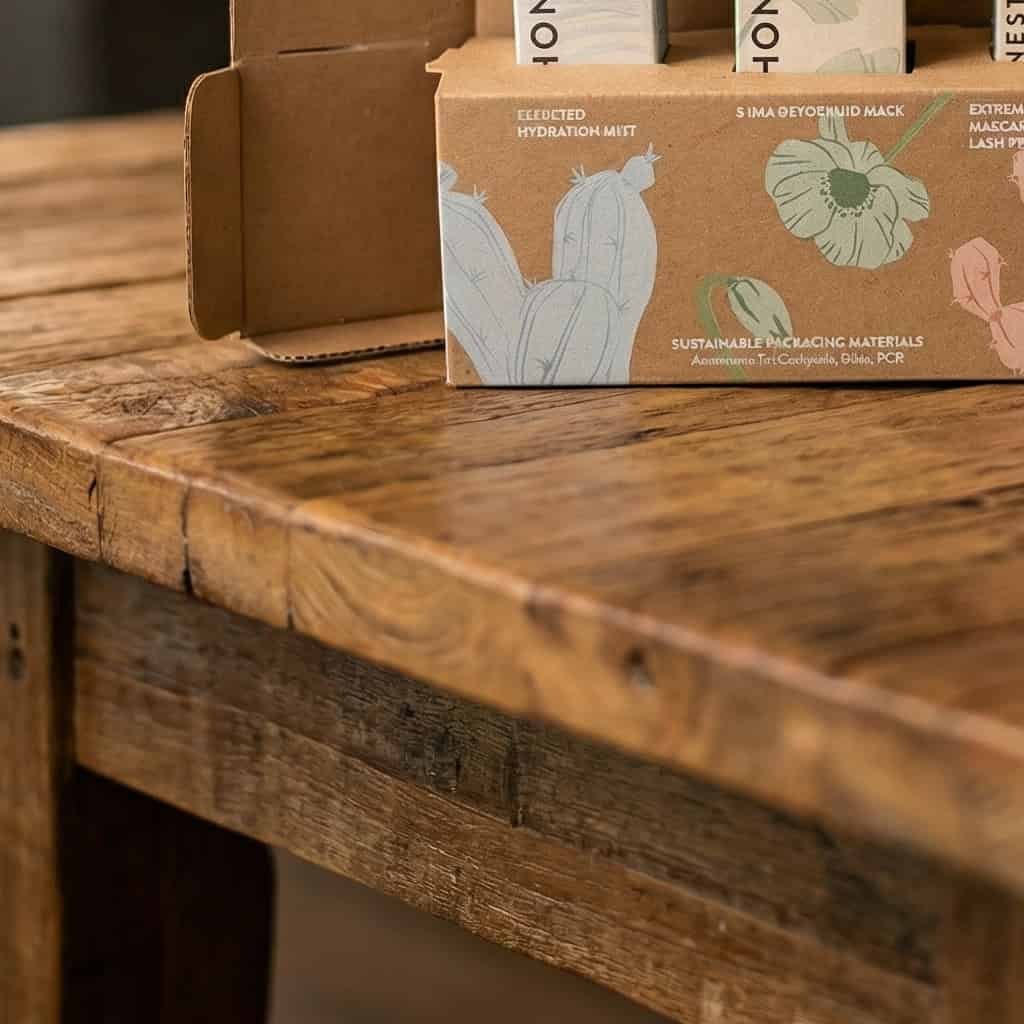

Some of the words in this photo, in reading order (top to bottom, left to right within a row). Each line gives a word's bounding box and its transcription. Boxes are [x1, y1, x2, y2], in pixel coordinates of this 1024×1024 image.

[864, 105, 905, 117] MACK
[969, 137, 1005, 149] LASH
[672, 338, 762, 350] SUSTAINABLE
[849, 336, 924, 348] MATERIALS
